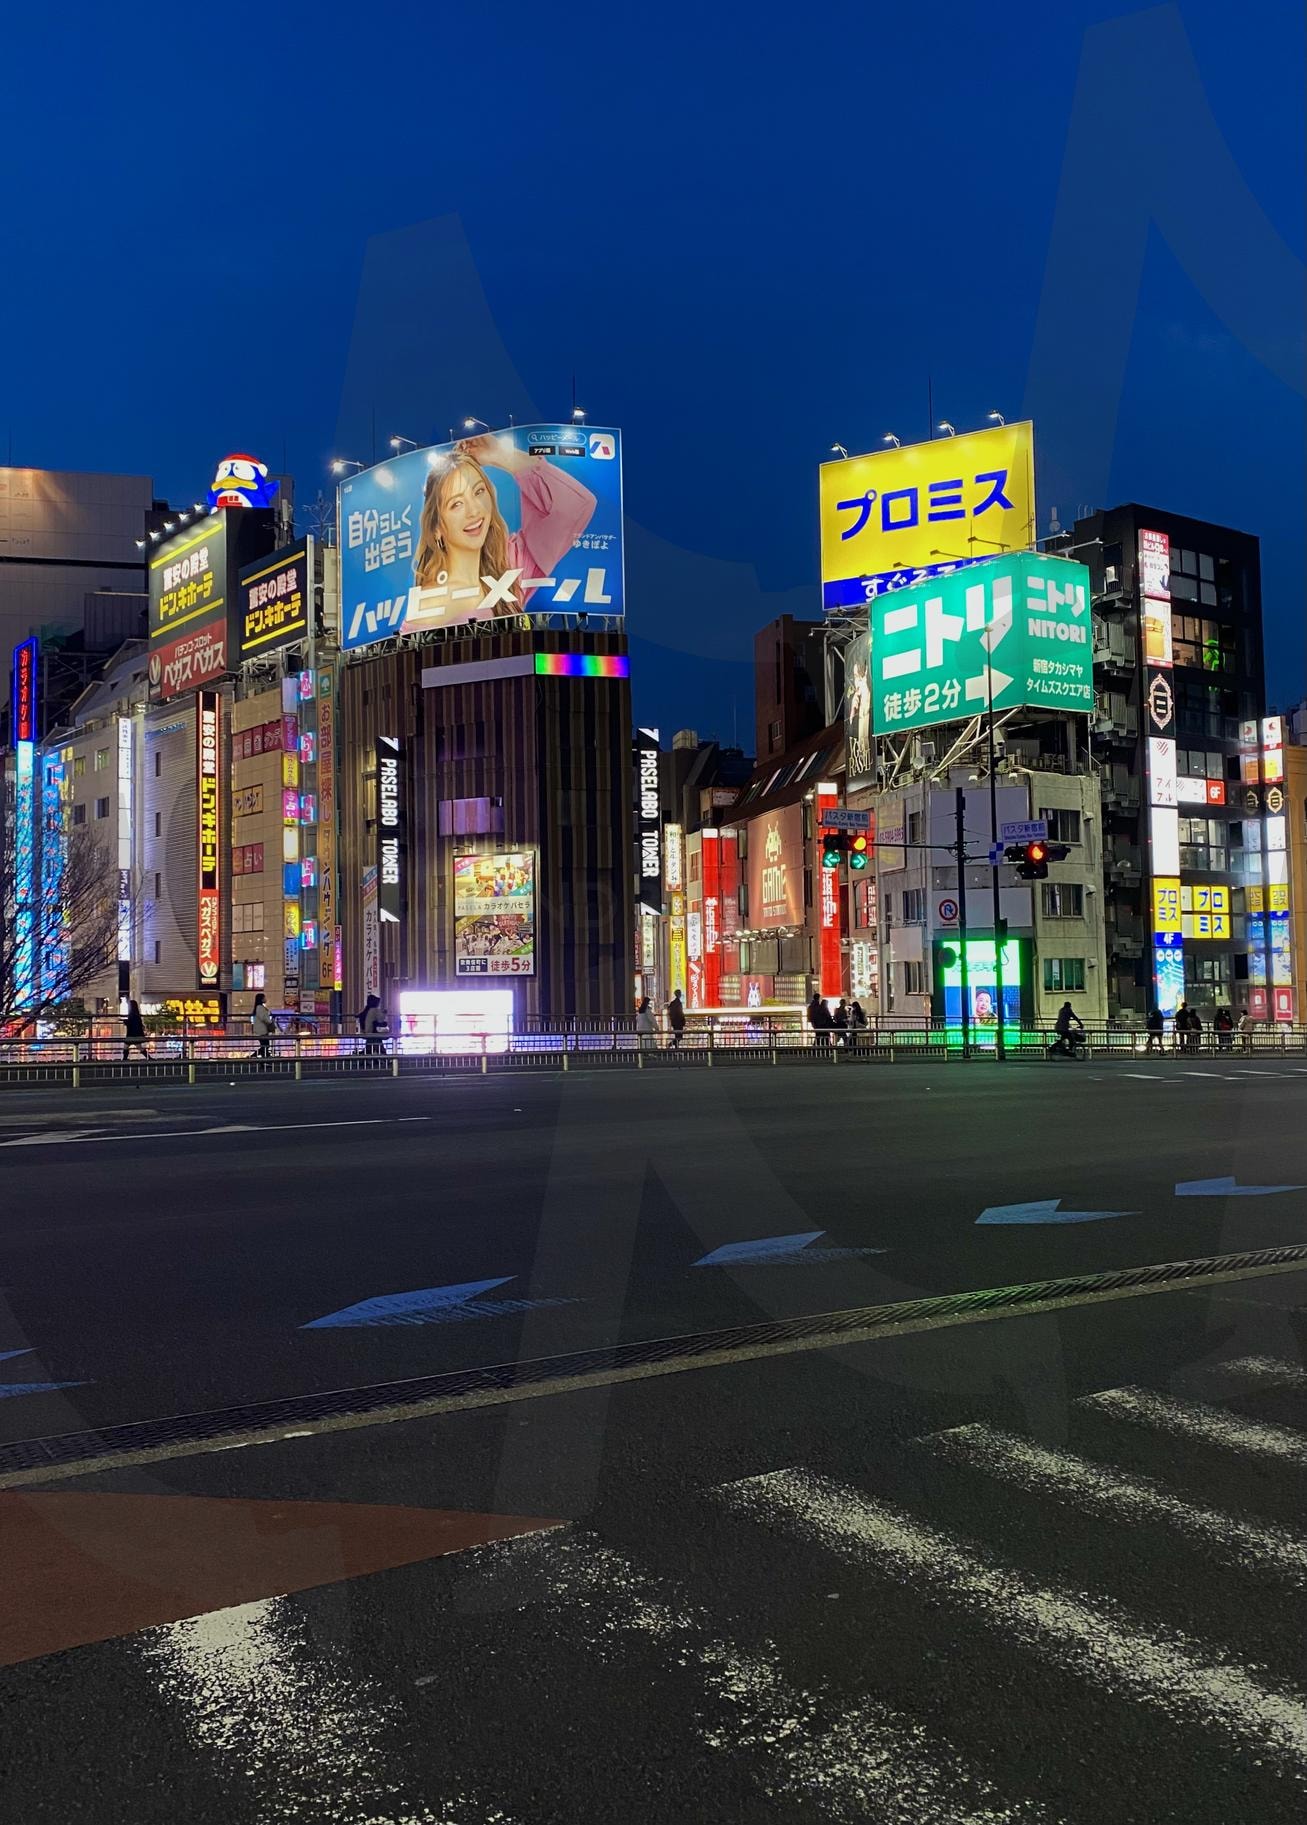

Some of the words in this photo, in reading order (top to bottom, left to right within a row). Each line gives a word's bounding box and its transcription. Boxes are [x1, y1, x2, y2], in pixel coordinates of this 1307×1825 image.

[836, 469, 1015, 541] プロミス
[348, 504, 412, 549] 自分らしく
[365, 531, 412, 573] 出会う
[348, 568, 612, 639] ハッピーメール
[1027, 576, 1085, 617] ニトリ
[882, 576, 1013, 680] ニトリ
[1028, 618, 1087, 644] NITORI
[1027, 677, 1091, 699] タイムズスクエア店
[1033, 658, 1083, 678] 新宿タカシマヤ
[884, 680, 962, 723] 徒歩2分
[321, 703, 332, 822] お部屋探し
[381, 758, 399, 826] PASELABO
[640, 750, 658, 819] PASELABO
[1004, 822, 1046, 834] バスタ新宿前
[382, 838, 400, 884] TOWER
[641, 830, 660, 877] TOWER
[762, 863, 787, 904] GAME
[1157, 889, 1178, 904] プロ
[1198, 890, 1223, 908] プロ
[1158, 907, 1178, 921] ミス
[1200, 916, 1224, 933] ミス
[322, 962, 332, 978] 6F
[491, 957, 531, 972] 徒歩5分
